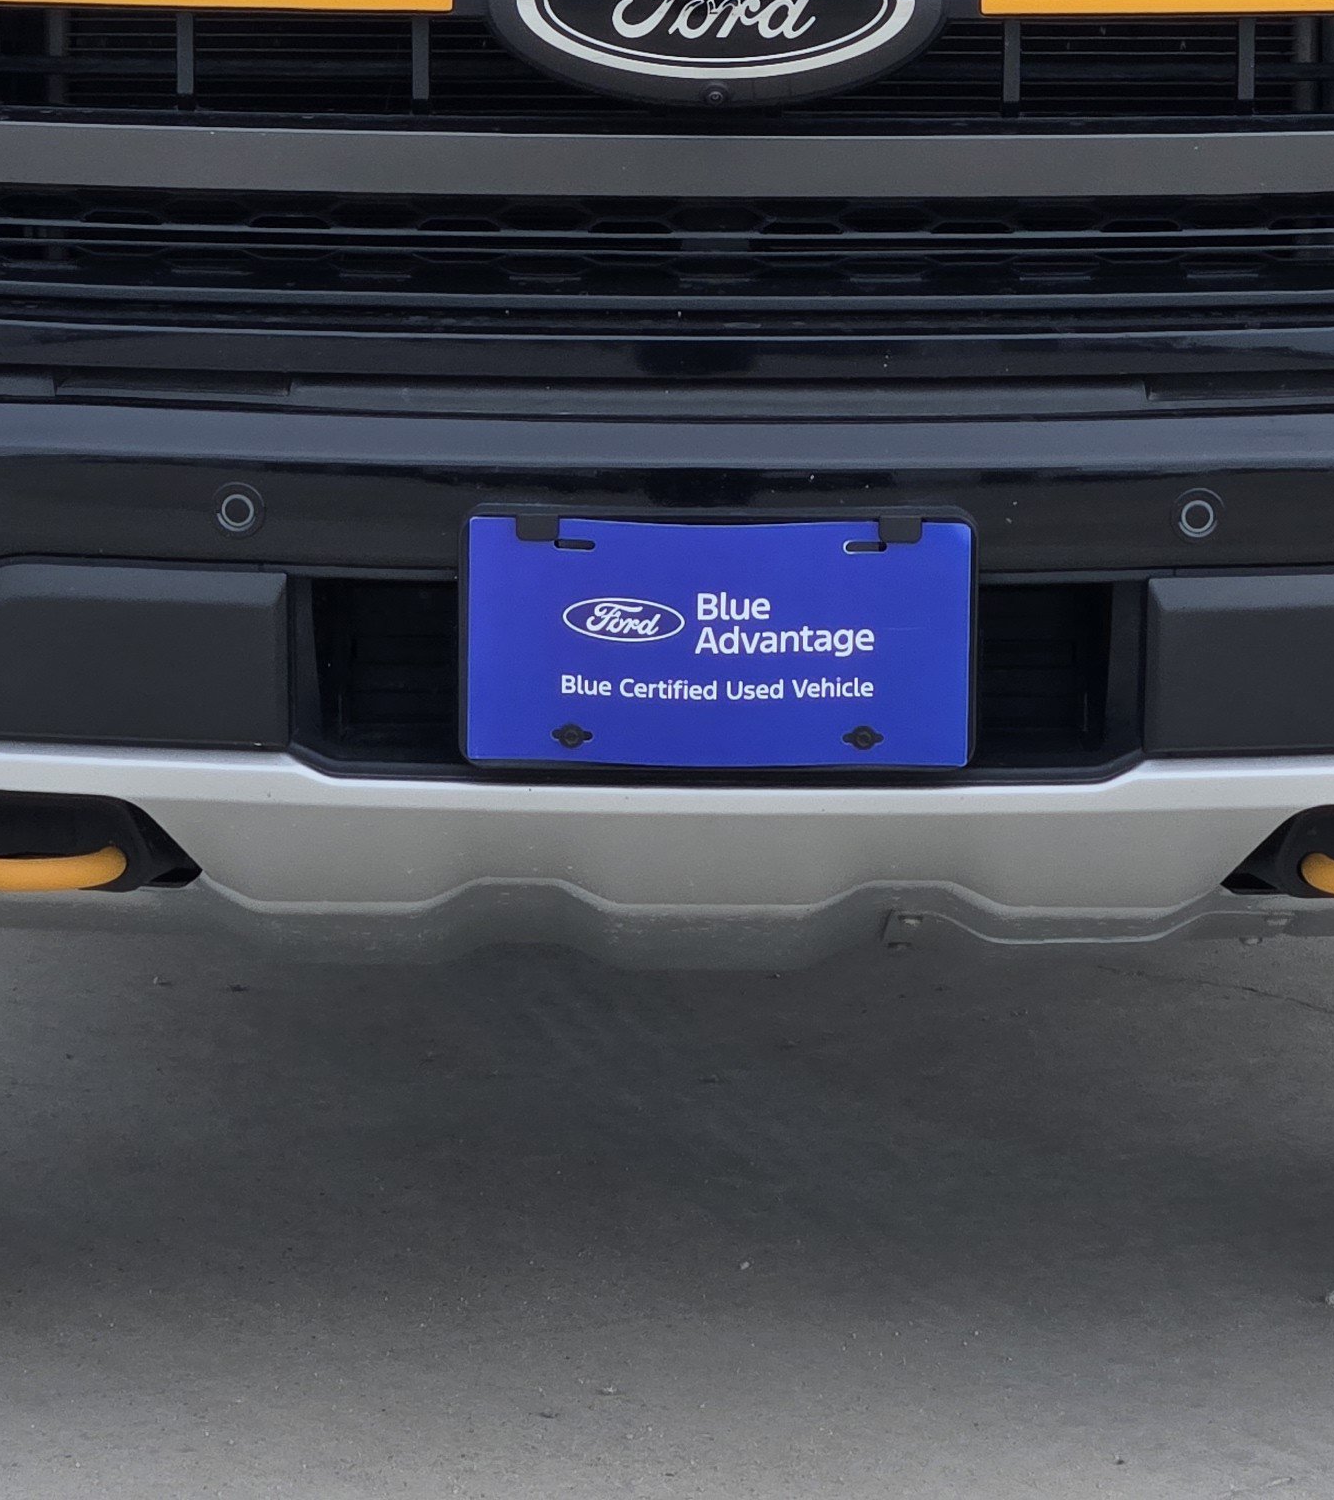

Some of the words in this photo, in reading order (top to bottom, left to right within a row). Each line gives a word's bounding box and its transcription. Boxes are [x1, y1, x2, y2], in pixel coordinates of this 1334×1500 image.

[586, 602, 660, 636] Ford
[697, 592, 771, 621] Blue
[695, 624, 875, 658] Advantage
[561, 674, 612, 697] Blue
[620, 677, 717, 701] Certified
[726, 679, 784, 701] Used
[792, 676, 874, 698] Vehicle
